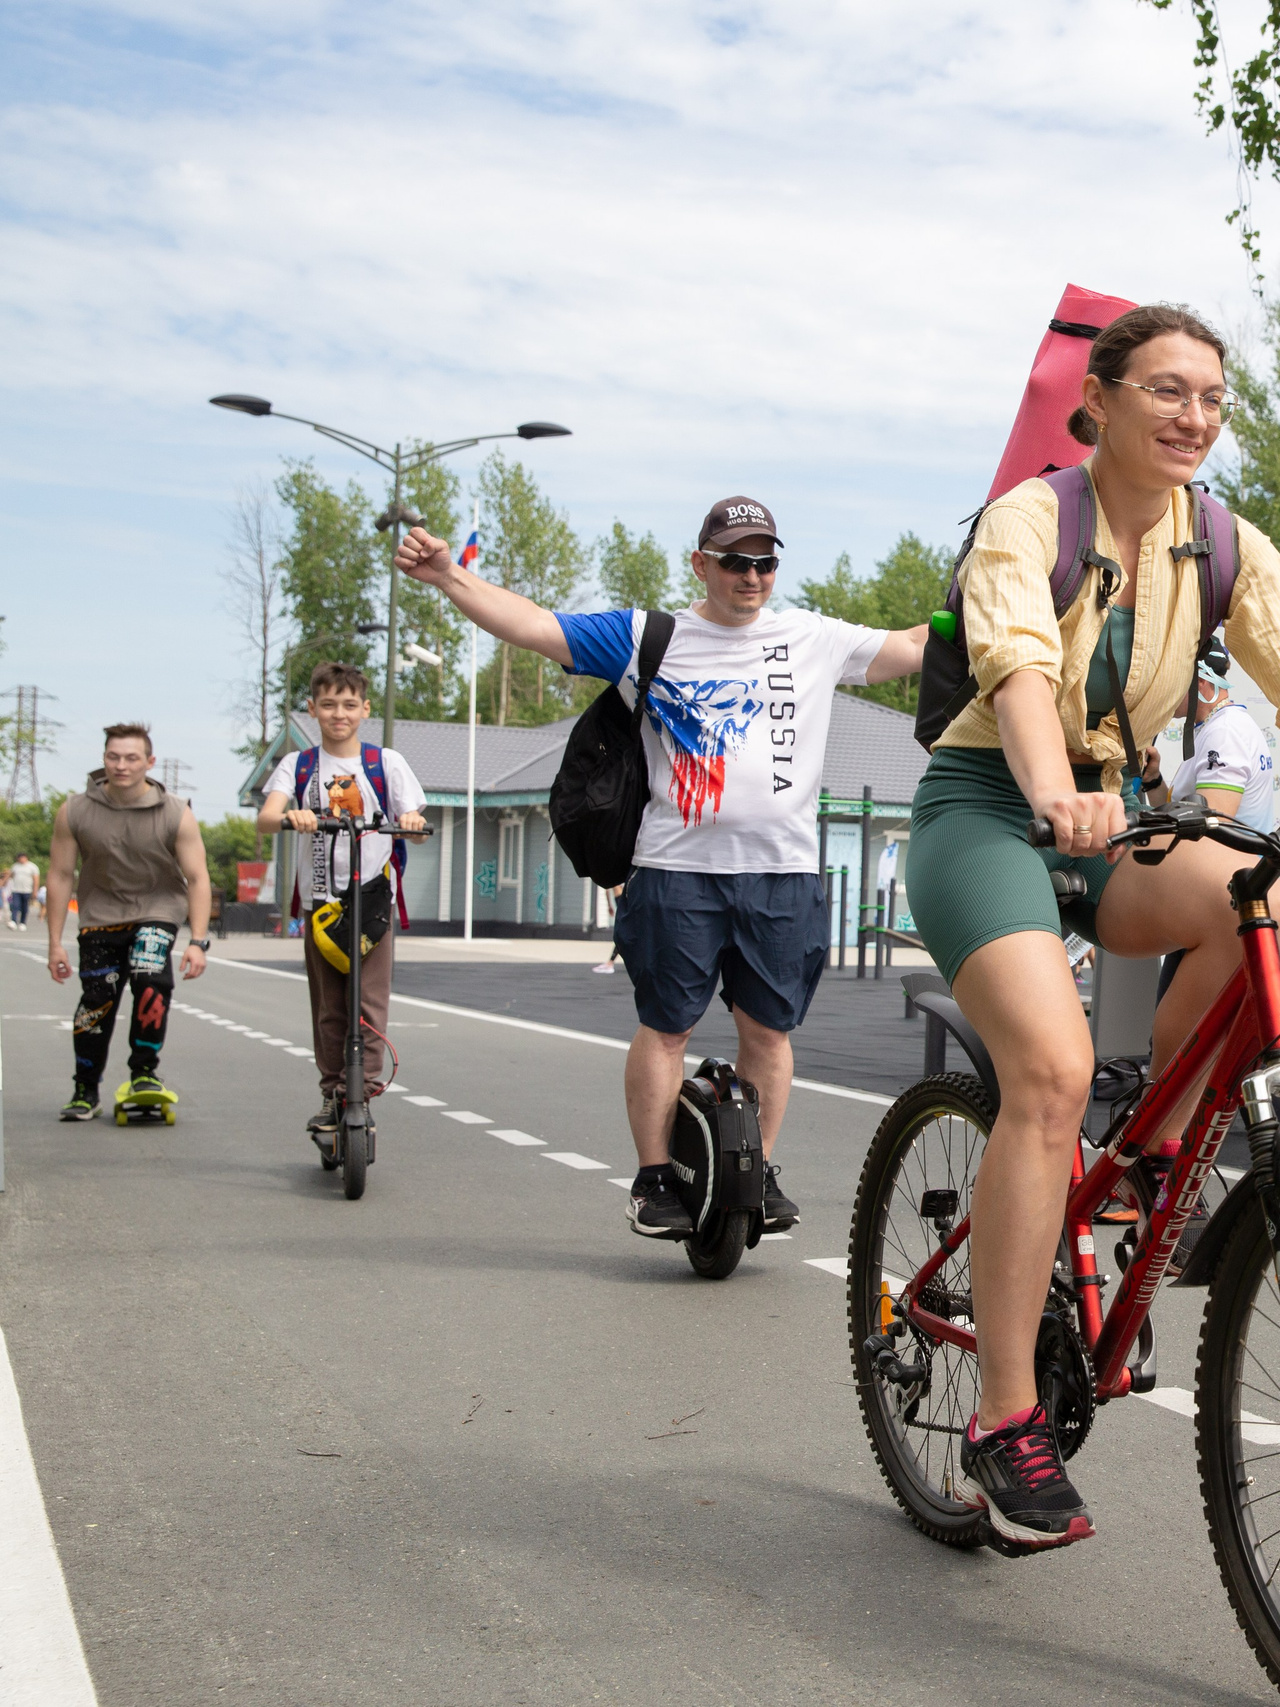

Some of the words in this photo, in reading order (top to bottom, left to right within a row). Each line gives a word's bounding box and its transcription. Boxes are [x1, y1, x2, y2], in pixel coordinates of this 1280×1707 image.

[725, 504, 765, 519] BOSS
[726, 517, 748, 527] HUGO
[751, 517, 769, 526] BOSS
[762, 643, 796, 795] RUSSIA
